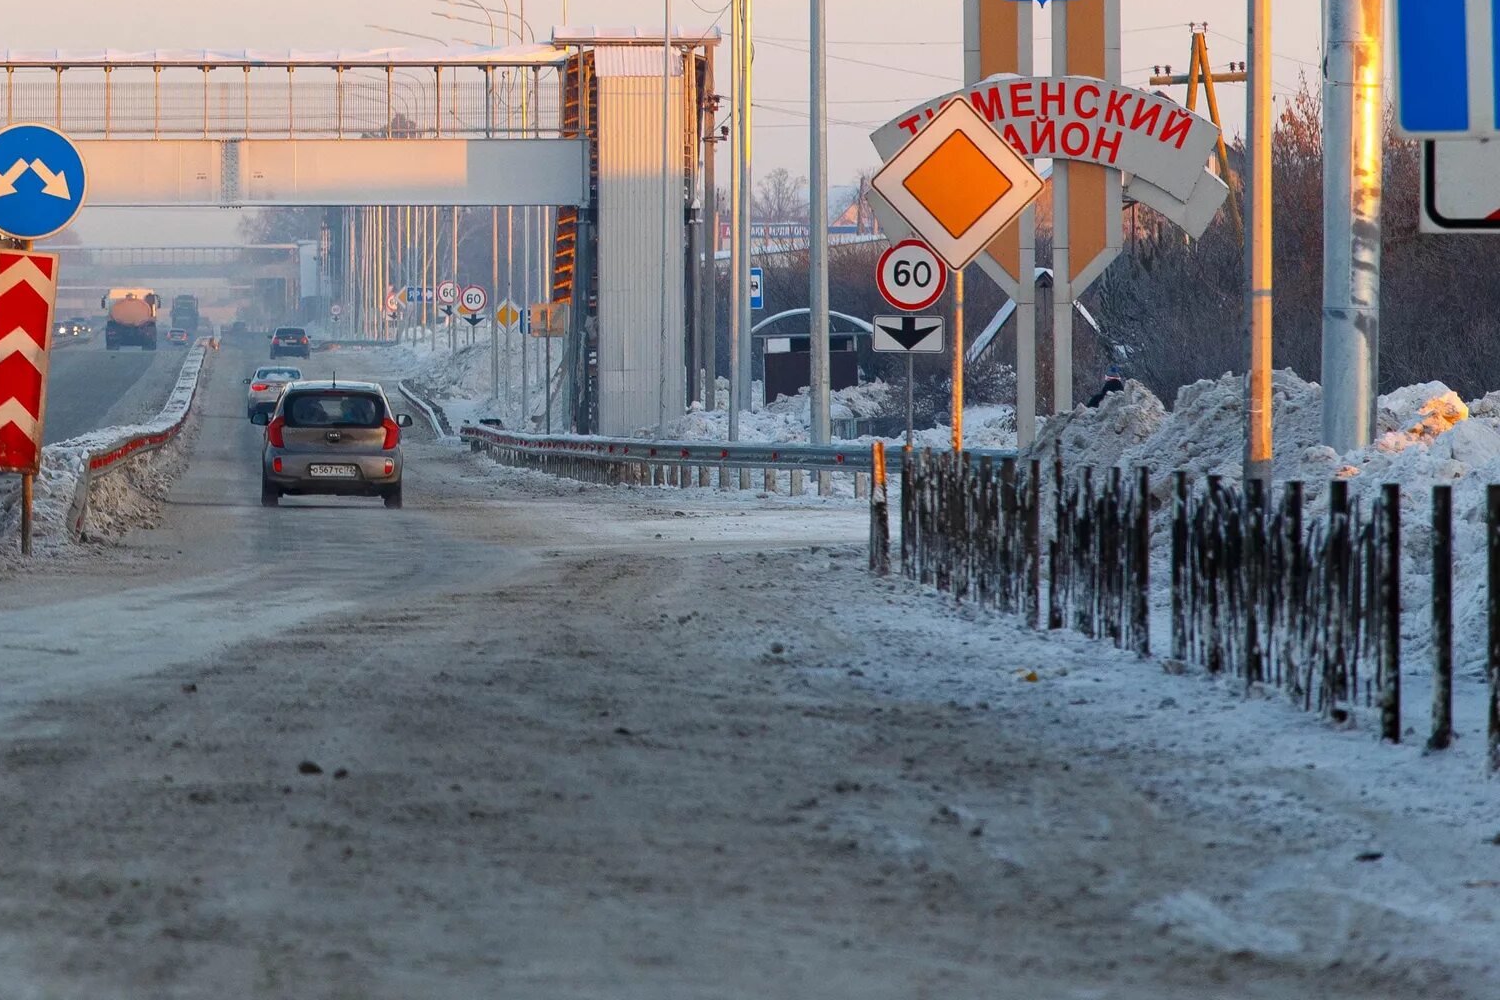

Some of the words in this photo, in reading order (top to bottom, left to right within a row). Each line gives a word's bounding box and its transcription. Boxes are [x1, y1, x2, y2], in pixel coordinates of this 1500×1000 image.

[898, 82, 1194, 150] ТМЕНСКИЙ
[1003, 115, 1123, 164] АЙОН
[893, 260, 932, 288] 60
[466, 294, 481, 304] 60
